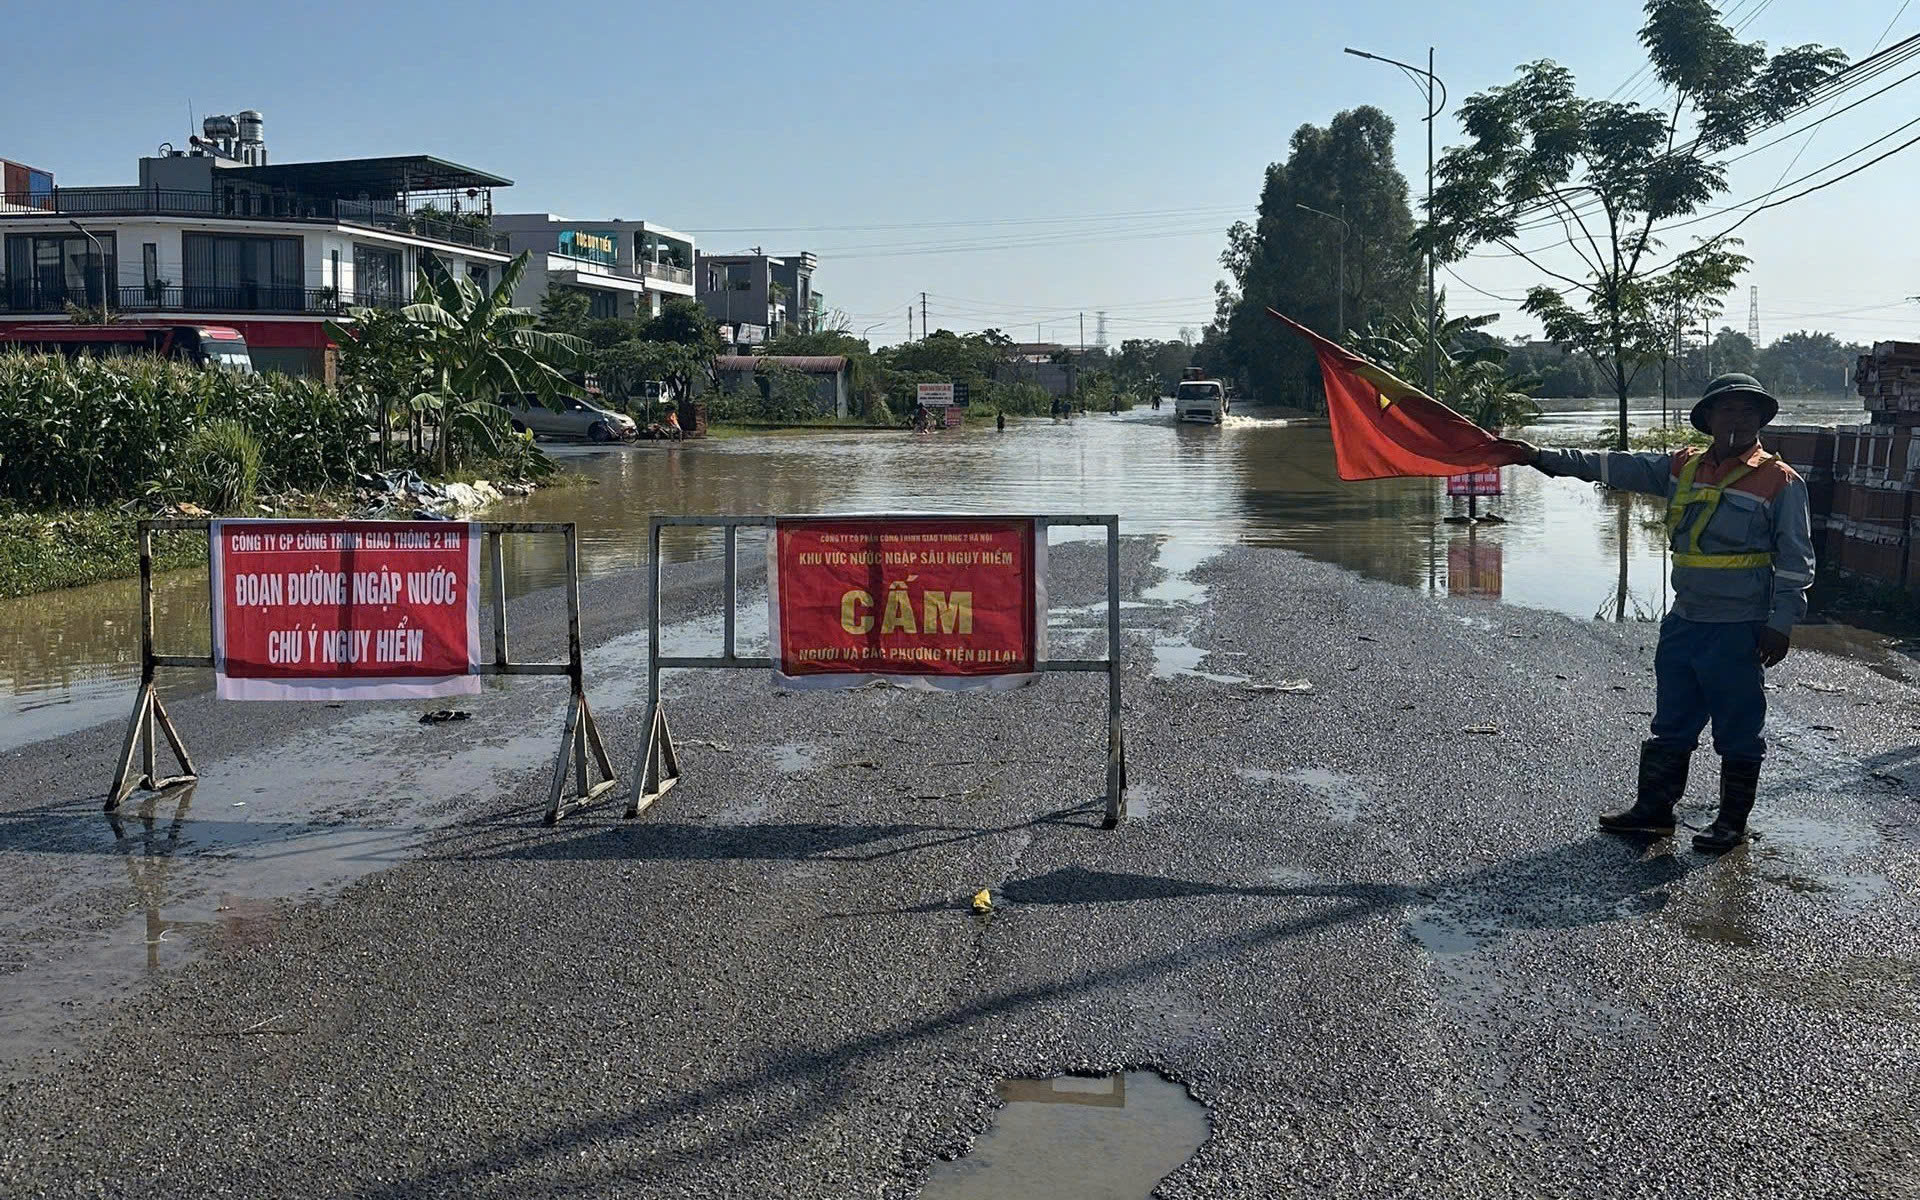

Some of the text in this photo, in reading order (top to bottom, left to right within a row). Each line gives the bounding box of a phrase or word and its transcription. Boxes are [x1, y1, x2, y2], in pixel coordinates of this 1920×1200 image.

[232, 529, 460, 551] CÔNG TY CP CÔNG TRÌNH GIAO THÔNG 2 HN
[799, 547, 1013, 567] KHU VỰC NƯỚC NGẬP SÂU NGUY HIỂM
[236, 564, 457, 613] ĐOẠN ĐƯỜNG NGẬP NƯỚC
[840, 574, 973, 635] CẤM
[268, 615, 424, 664] CHÚ Ý NGUY HIỂM
[799, 645, 839, 660] NGƯỜI
[843, 645, 858, 660] VÀ
[890, 646, 941, 660] PHƯƠNG
[945, 646, 974, 664] TIỆN
[978, 649, 991, 662] ĐI
